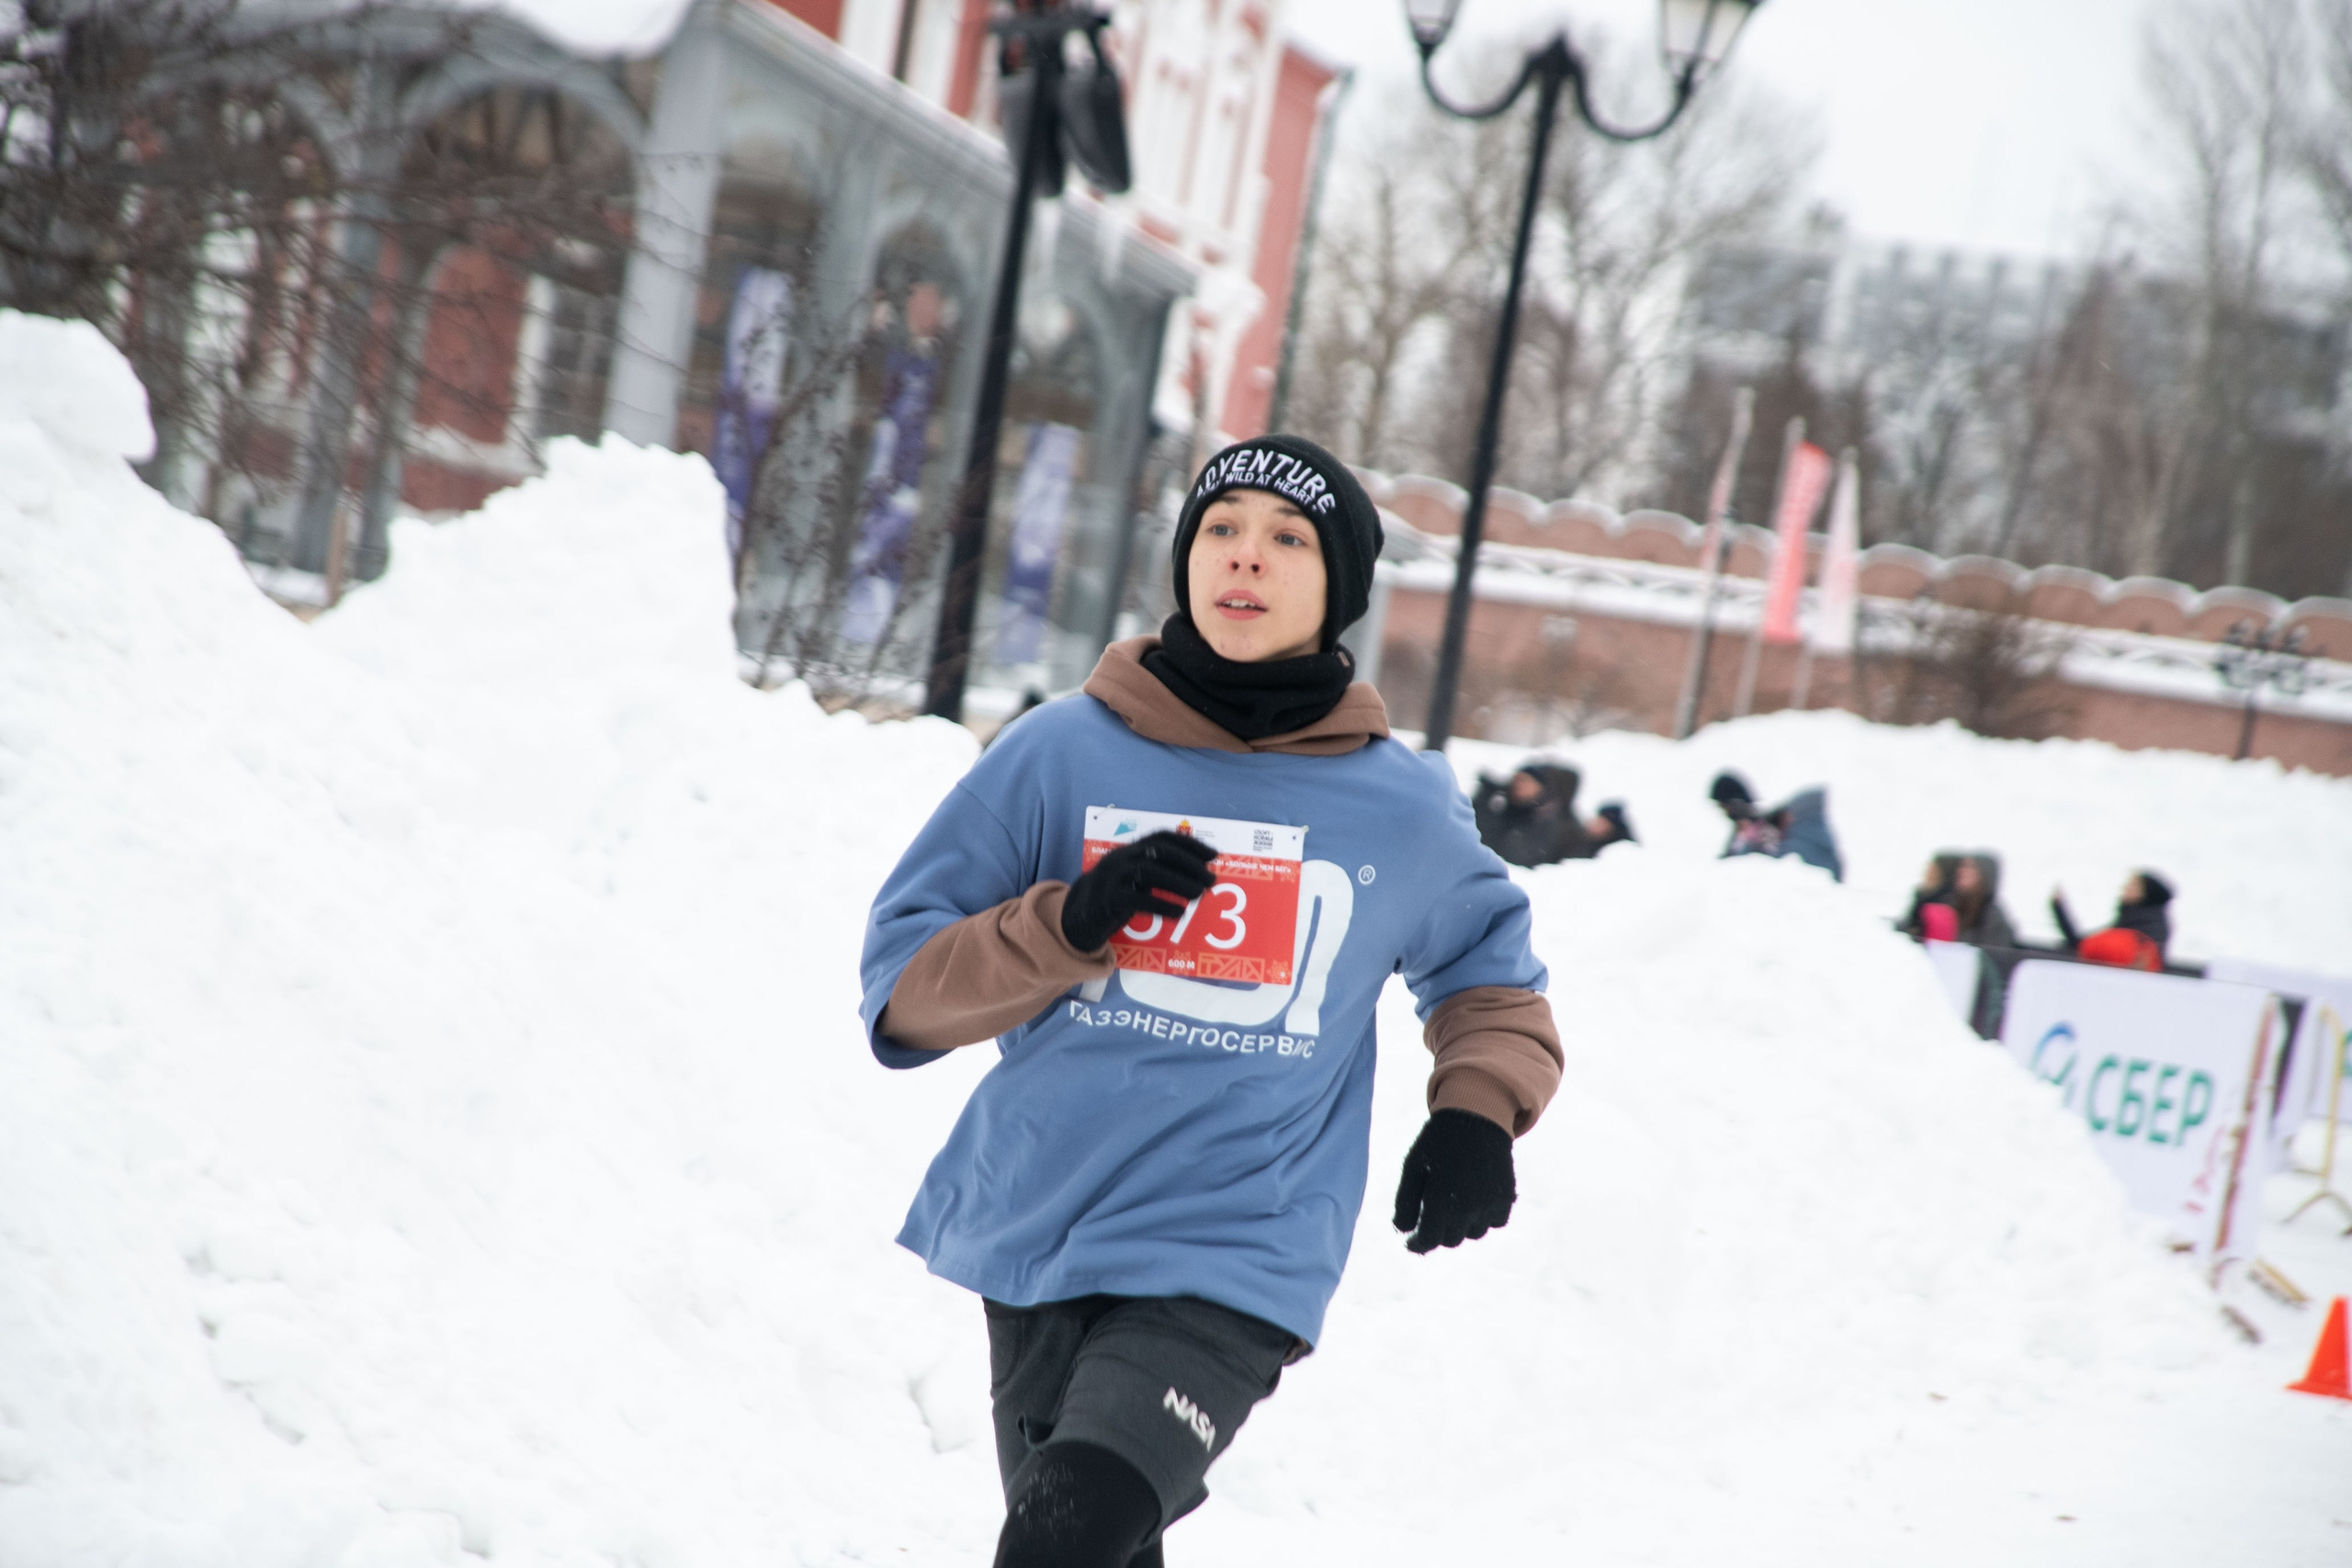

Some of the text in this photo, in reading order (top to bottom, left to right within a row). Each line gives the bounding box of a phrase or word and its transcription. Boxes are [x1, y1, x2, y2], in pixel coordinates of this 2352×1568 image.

[1196, 448, 1336, 514] ADVENTURE
[1225, 471, 1313, 505] WILD AT HEART
[1168, 958, 1185, 969] 600
[2086, 1054, 2214, 1147] СБЕР
[1162, 1386, 1216, 1452] NASA
